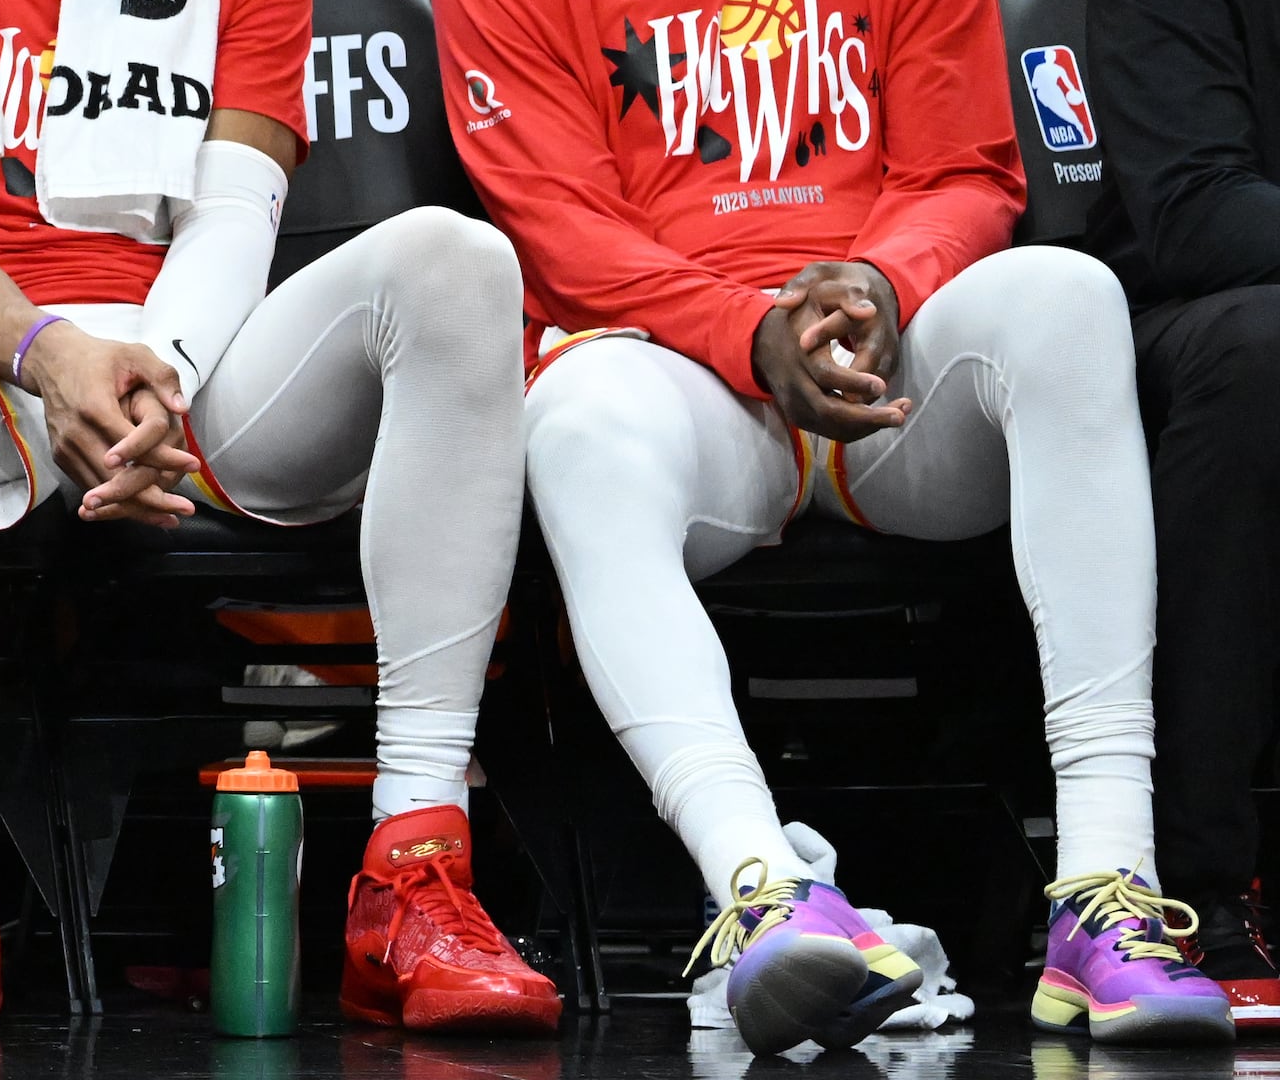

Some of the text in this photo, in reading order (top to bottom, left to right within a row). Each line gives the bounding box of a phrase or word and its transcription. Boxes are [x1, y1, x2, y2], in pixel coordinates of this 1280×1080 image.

[1049, 125, 1077, 145] NBA
[712, 190, 749, 216] 2026
[761, 184, 825, 205] PLAYOFFS
